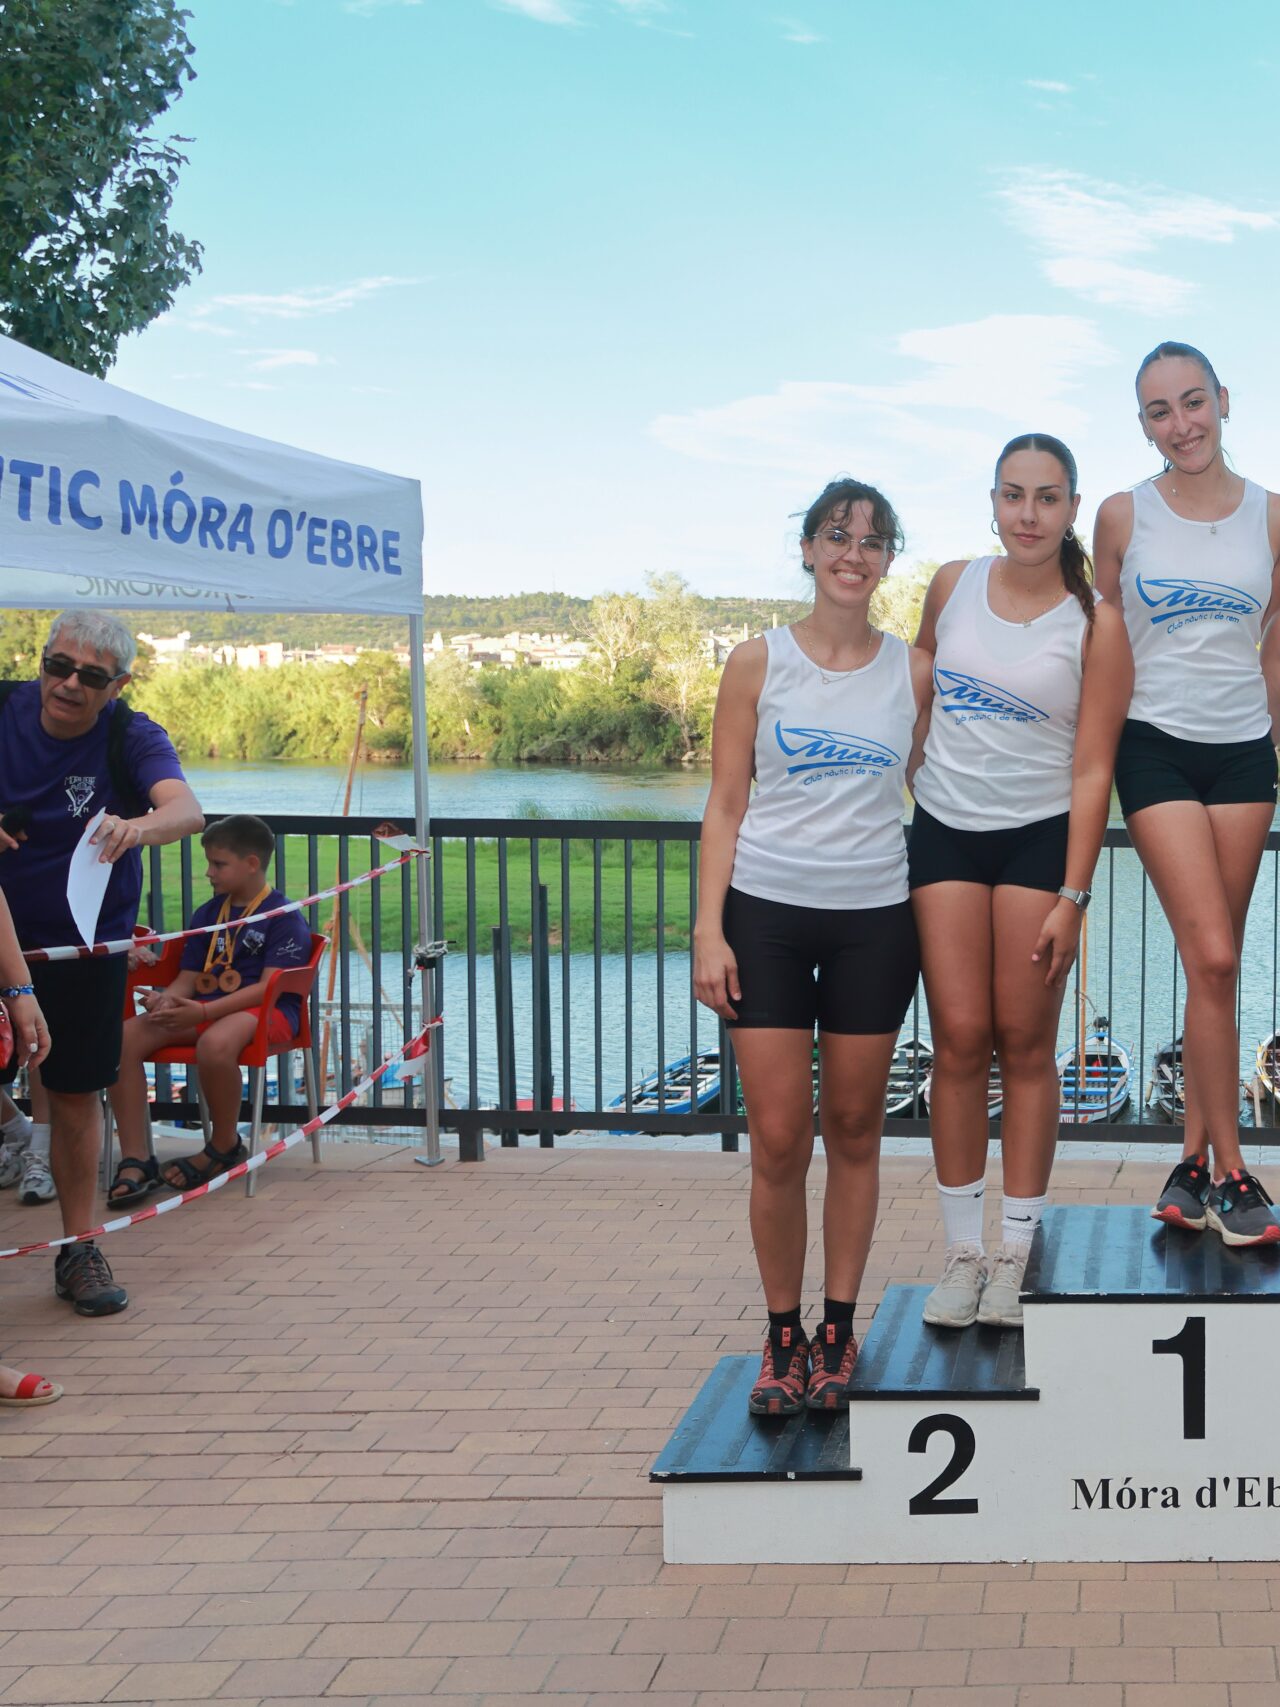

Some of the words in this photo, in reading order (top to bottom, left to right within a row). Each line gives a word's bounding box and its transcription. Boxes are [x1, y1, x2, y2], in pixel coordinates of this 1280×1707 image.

[0, 456, 103, 531] TIC
[119, 470, 255, 555] MÓRA
[266, 508, 402, 575] D'EBRE
[1214, 611, 1225, 620] de
[1226, 615, 1240, 624] rem
[803, 773, 823, 786] Club
[855, 767, 866, 775] de
[868, 769, 883, 777] rem
[1152, 1316, 1206, 1440] 1
[907, 1413, 979, 1516] 2
[1071, 1477, 1181, 1510] Móra
